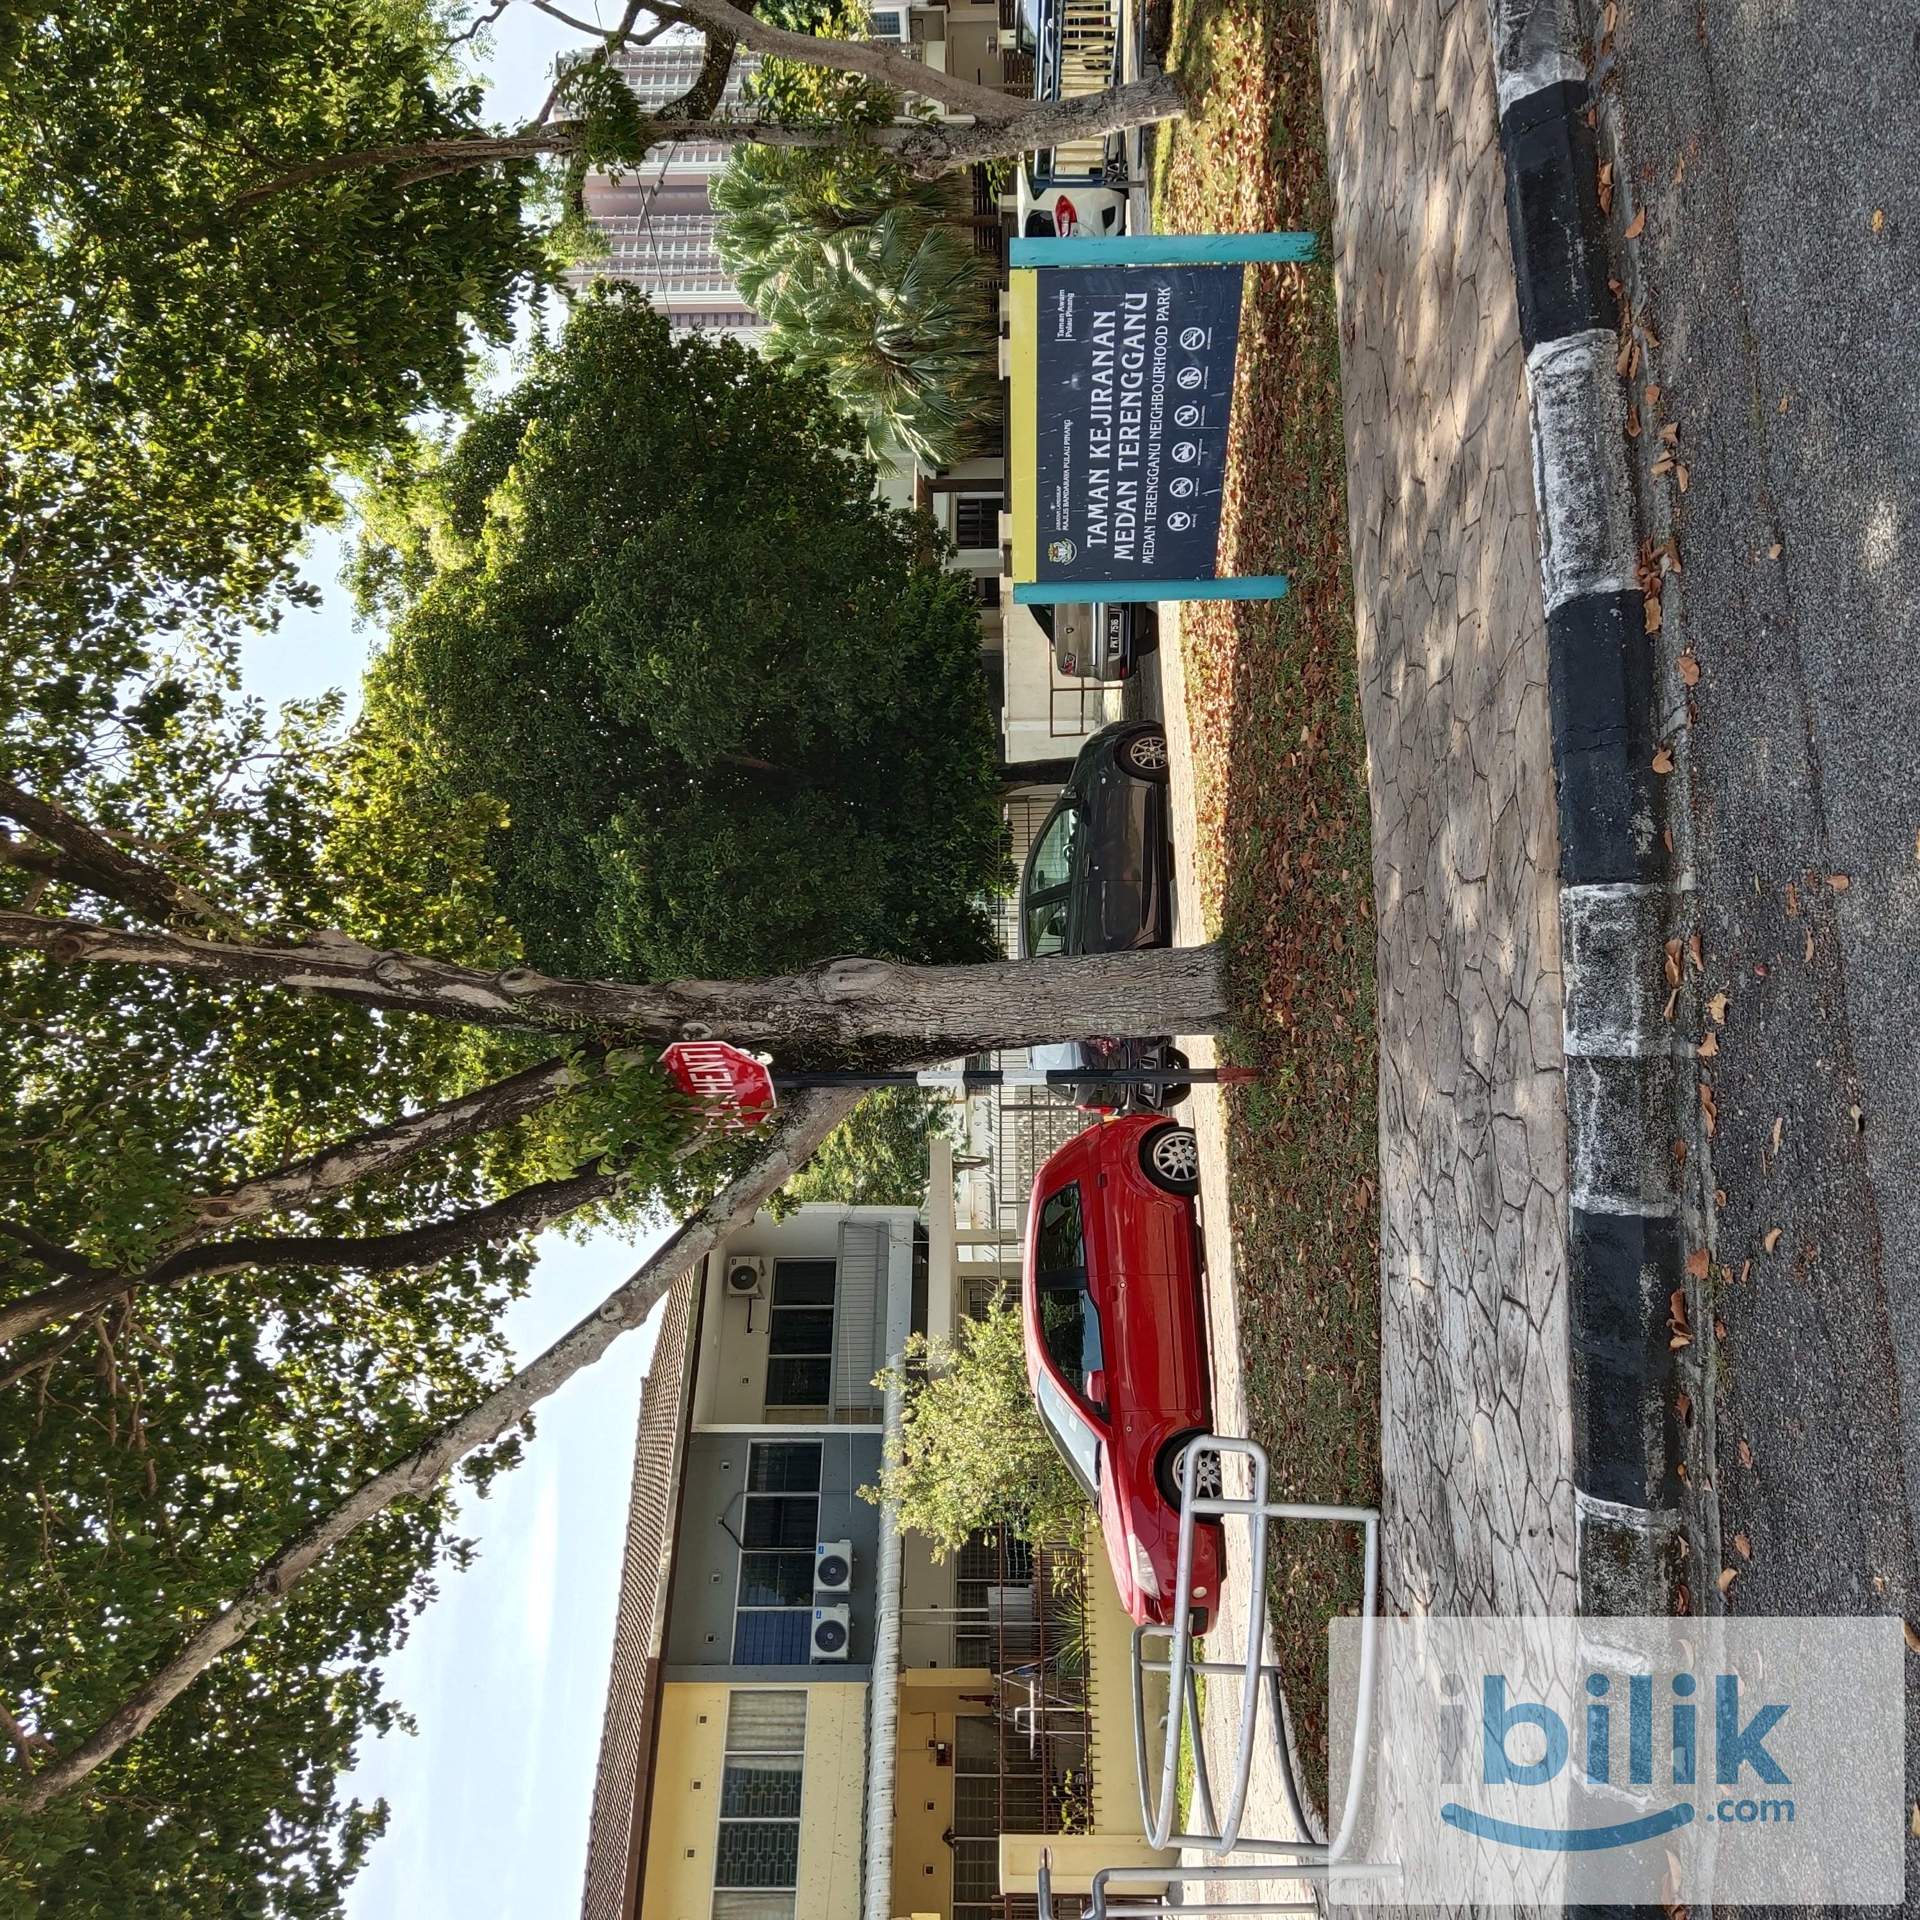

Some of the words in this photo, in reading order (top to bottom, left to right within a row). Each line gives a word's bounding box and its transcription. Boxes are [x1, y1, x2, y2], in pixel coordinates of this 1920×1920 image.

[1057, 289, 1065, 312] Awam
[1066, 292, 1075, 317] Pinang
[1156, 287, 1171, 321] PARK
[1057, 313, 1065, 338] Taman
[1065, 317, 1073, 338] Pulau
[1089, 310, 1116, 459] KEJIRANAN
[1117, 292, 1148, 471] TERENGGANU
[1149, 325, 1168, 440] NEIGHBOURHOOD
[1064, 419, 1072, 445] PINANG
[1063, 445, 1071, 468] PULAU
[1144, 443, 1161, 522] TERENGGANU
[1062, 508, 1070, 531] MAJLIS
[1087, 469, 1110, 548] TAMAN
[1114, 480, 1138, 560] MEDAN
[1142, 525, 1156, 564] MEDAN
